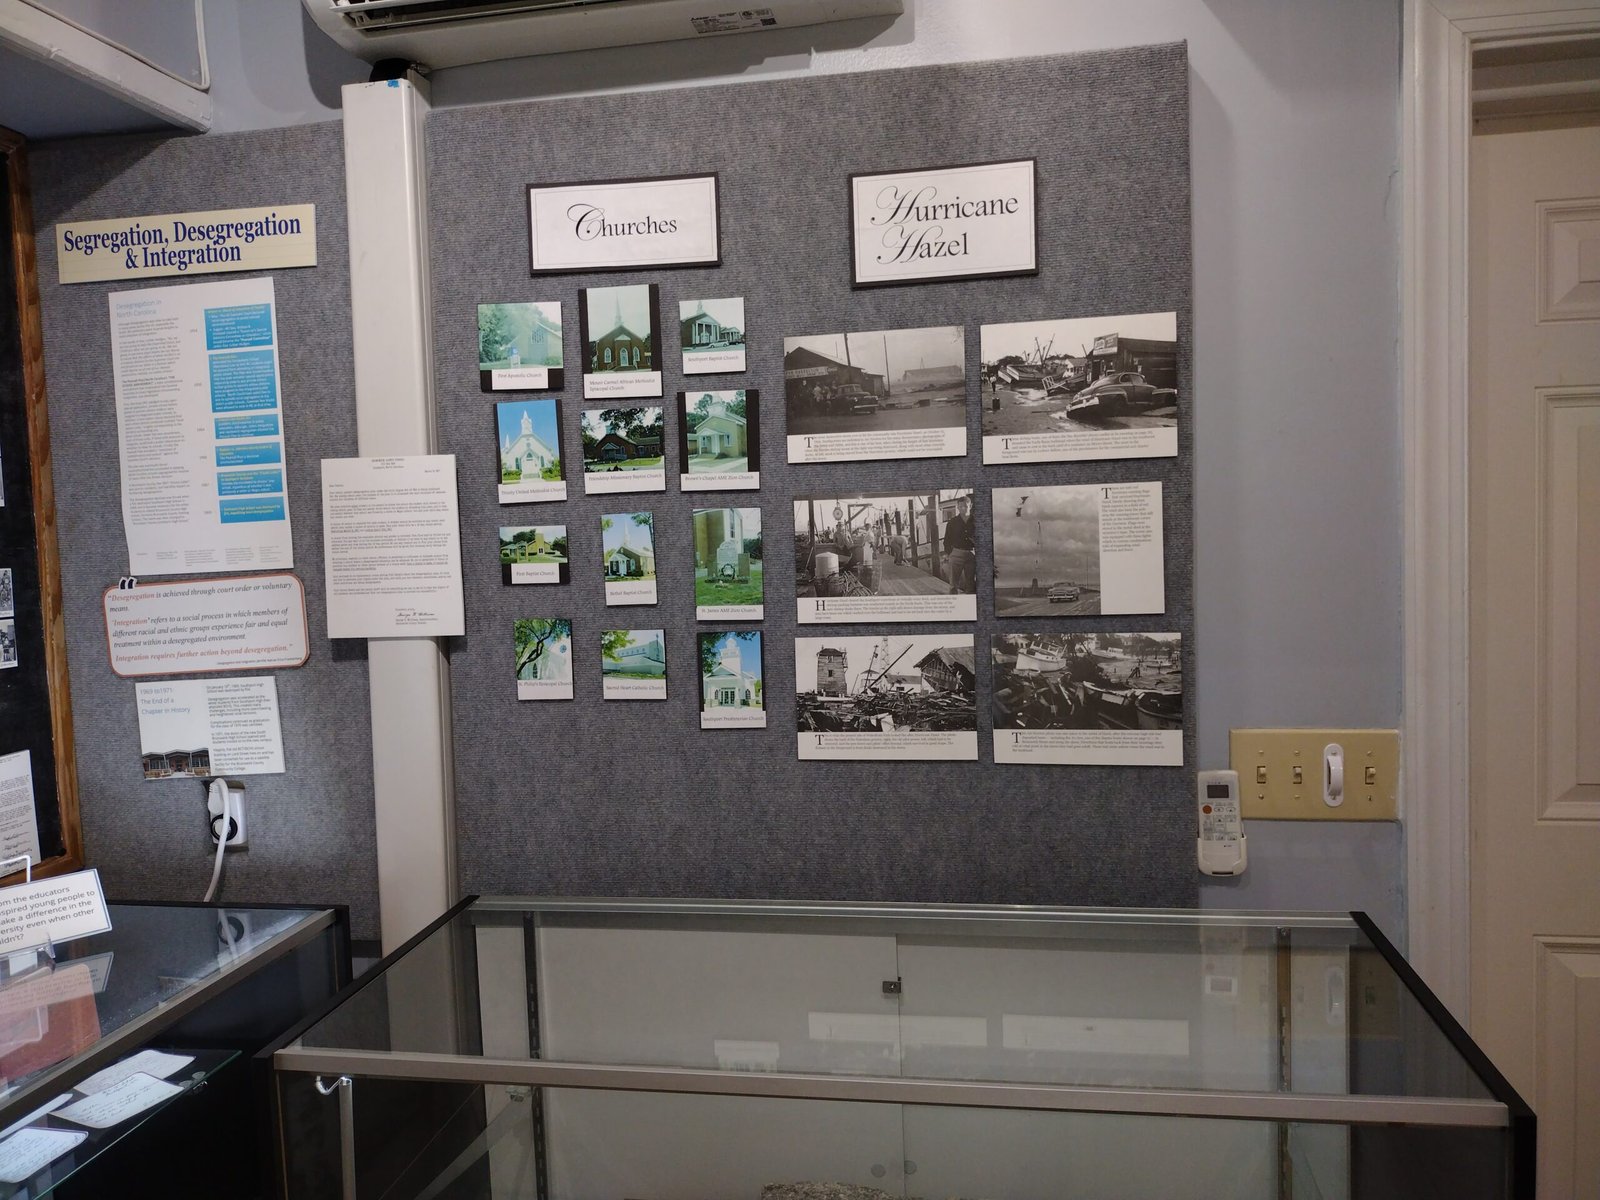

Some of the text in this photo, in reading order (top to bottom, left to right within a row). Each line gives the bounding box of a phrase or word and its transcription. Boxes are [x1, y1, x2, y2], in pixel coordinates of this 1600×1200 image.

[870, 186, 1019, 226] Hurricane
[567, 203, 678, 241] Churches
[64, 213, 301, 255] Segregation, Desegregation
[876, 225, 970, 264] Hazel
[125, 240, 241, 271] & Integration
[162, 589, 189, 598] achieved
[190, 587, 216, 596] through
[217, 586, 234, 594] court
[262, 582, 293, 590] voluntary
[150, 616, 168, 624] refers
[201, 613, 224, 621] process
[233, 610, 252, 618] which
[252, 608, 279, 617] members
[281, 607, 288, 616] of
[112, 629, 137, 638] different
[189, 625, 210, 633] groups
[211, 623, 244, 631] experience
[244, 621, 256, 629] fair
[270, 619, 288, 628] equal
[113, 640, 142, 648] treatment
[168, 636, 207, 645] desegregated
[115, 653, 149, 662] Integration
[150, 652, 176, 660] requires
[176, 649, 199, 658] further
[220, 647, 242, 656] beyond
[13, 896, 27, 904] the
[29, 886, 70, 900] educators
[30, 901, 56, 911] young
[57, 892, 85, 904] people
[0, 908, 95, 935] ersity even when other
[25, 906, 67, 920] difference
